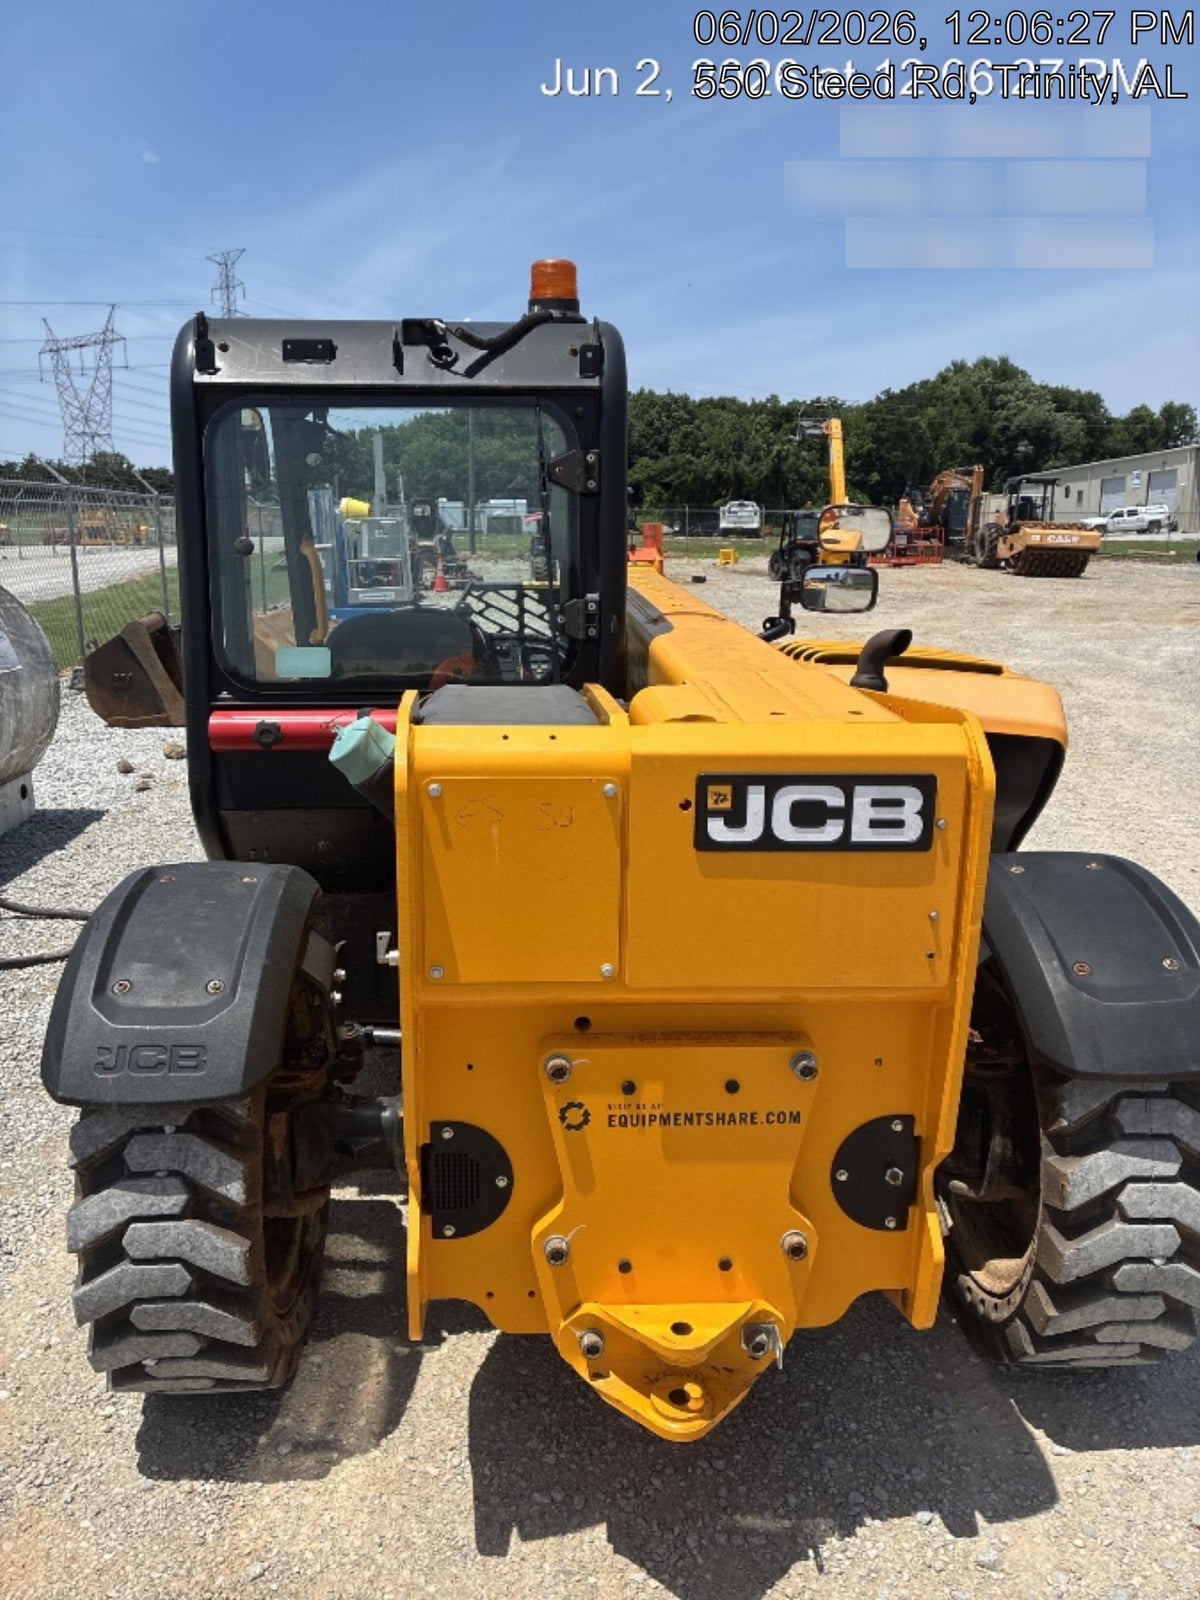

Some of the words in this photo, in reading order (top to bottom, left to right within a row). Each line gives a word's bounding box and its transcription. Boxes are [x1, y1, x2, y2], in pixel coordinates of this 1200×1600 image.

[706, 784, 924, 843] JCB
[94, 1044, 207, 1079] JCB
[607, 1110, 802, 1128] EQUIPMENTSHARE.COM
